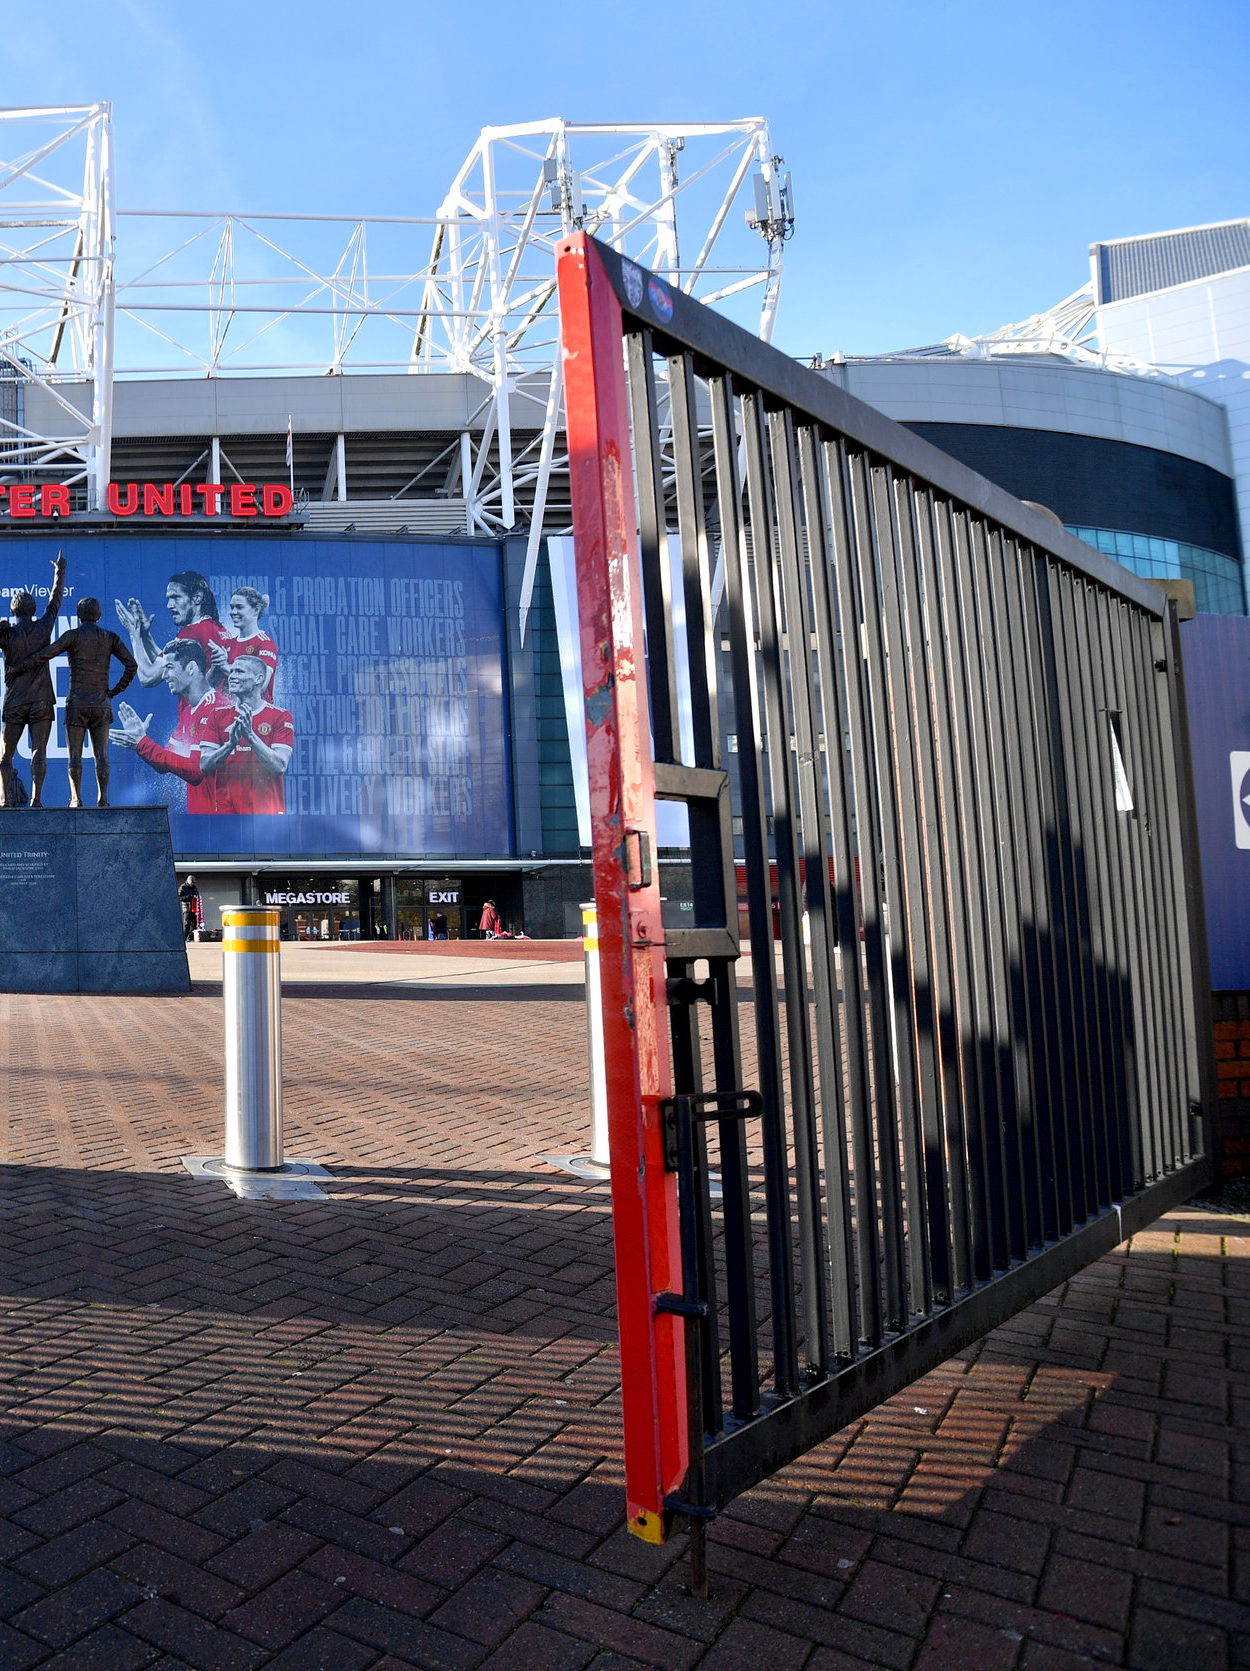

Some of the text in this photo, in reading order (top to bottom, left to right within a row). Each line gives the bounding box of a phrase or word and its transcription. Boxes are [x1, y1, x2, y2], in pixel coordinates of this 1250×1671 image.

[108, 483, 294, 517] UNITED
[275, 577, 287, 614] &
[293, 577, 385, 616] PROBATION
[390, 578, 464, 618] OFFICERS
[268, 616, 466, 657] SOCIAL CARE WORKERS
[336, 655, 468, 695] PROFESSIONALS
[285, 775, 473, 817] DELIVERY WORKERS
[265, 891, 460, 904] MEGASTORE EXIT
